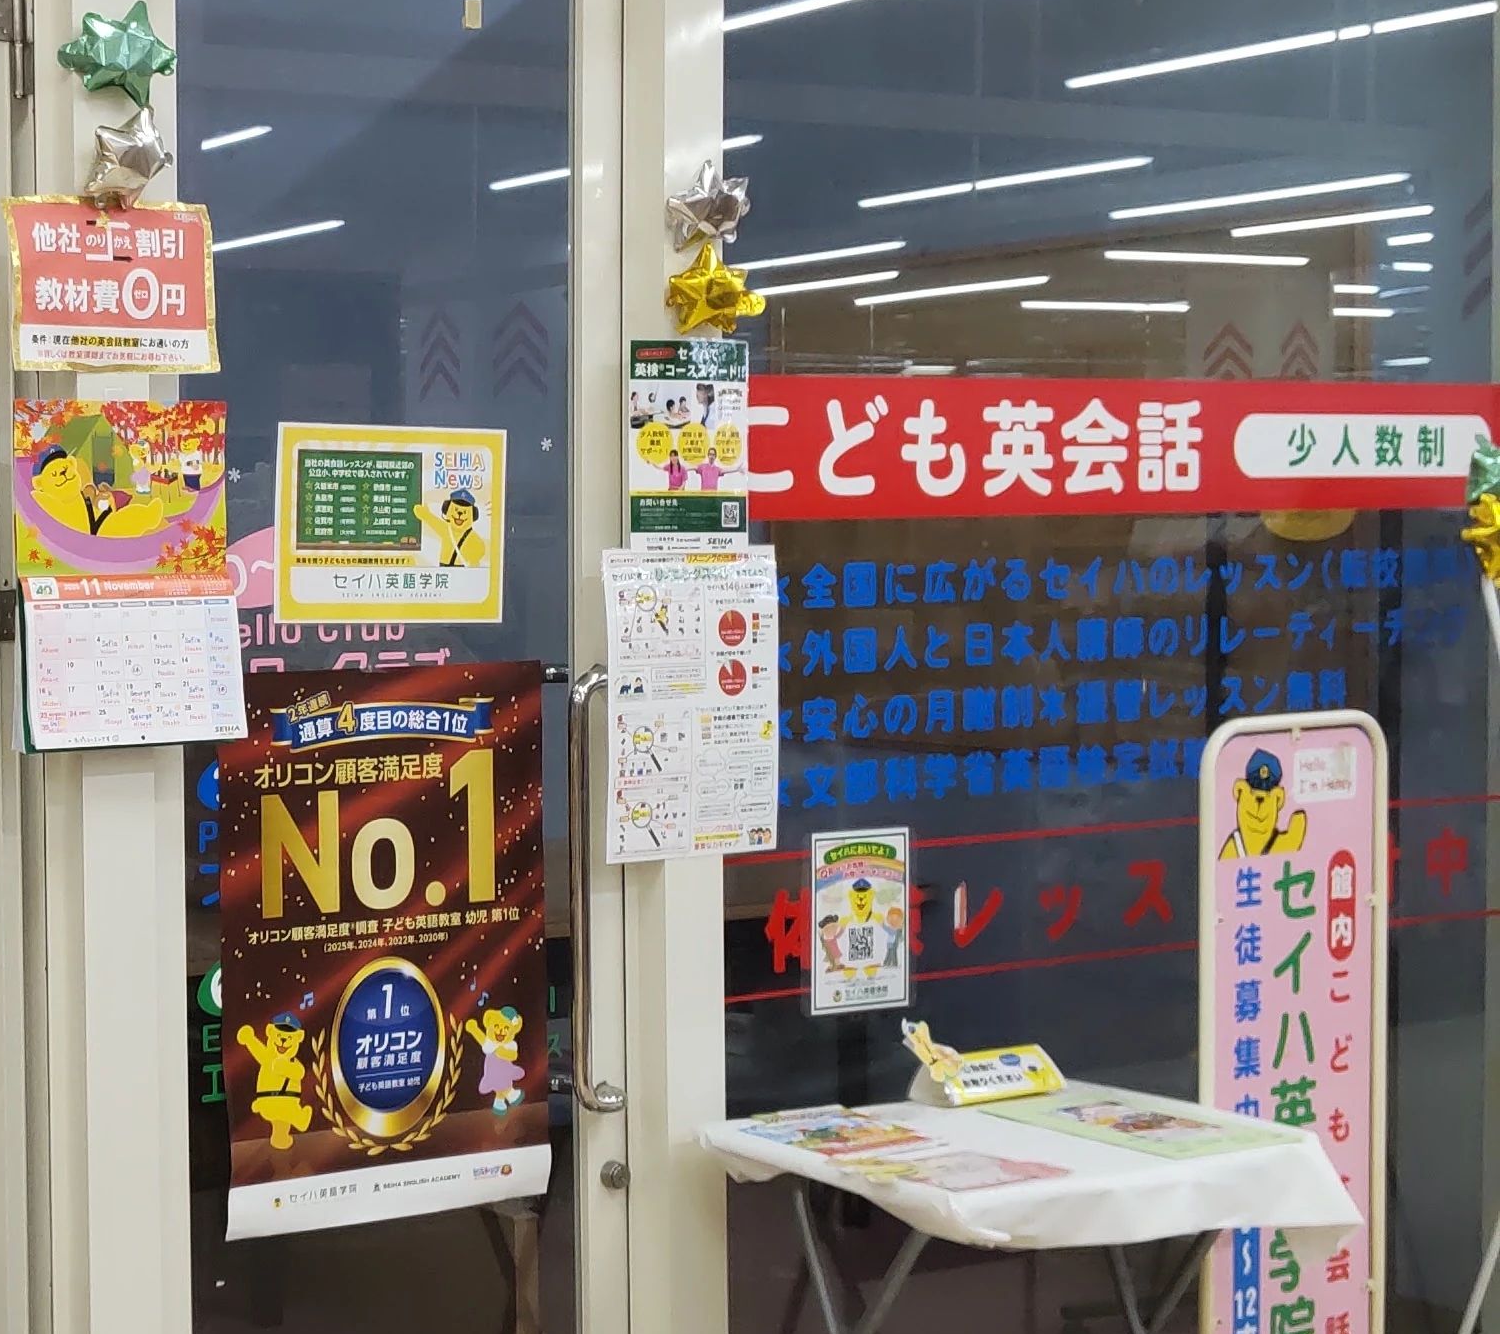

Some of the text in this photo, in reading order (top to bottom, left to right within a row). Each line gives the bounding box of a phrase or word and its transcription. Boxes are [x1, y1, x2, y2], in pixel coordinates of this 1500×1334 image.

[747, 395, 1202, 497] こども英会話
[1288, 421, 1447, 469] 少人数制
[434, 451, 485, 471] SEIHA
[434, 472, 483, 489] News
[80, 577, 100, 596] 11
[103, 581, 155, 592] November
[333, 573, 449, 589] セイハ英語学院
[238, 613, 302, 647] ello
[298, 702, 468, 743] 通算4度目の総合1位
[253, 752, 444, 789] オリコン顧客満足度
[260, 748, 496, 919] No.1
[382, 911, 462, 934] 子ども英語教室
[465, 909, 488, 925] 幼児
[491, 907, 520, 923] 第1位
[366, 983, 411, 1021] 第1位
[355, 1029, 423, 1056] オリコン
[355, 1050, 422, 1070] 顧客満足度
